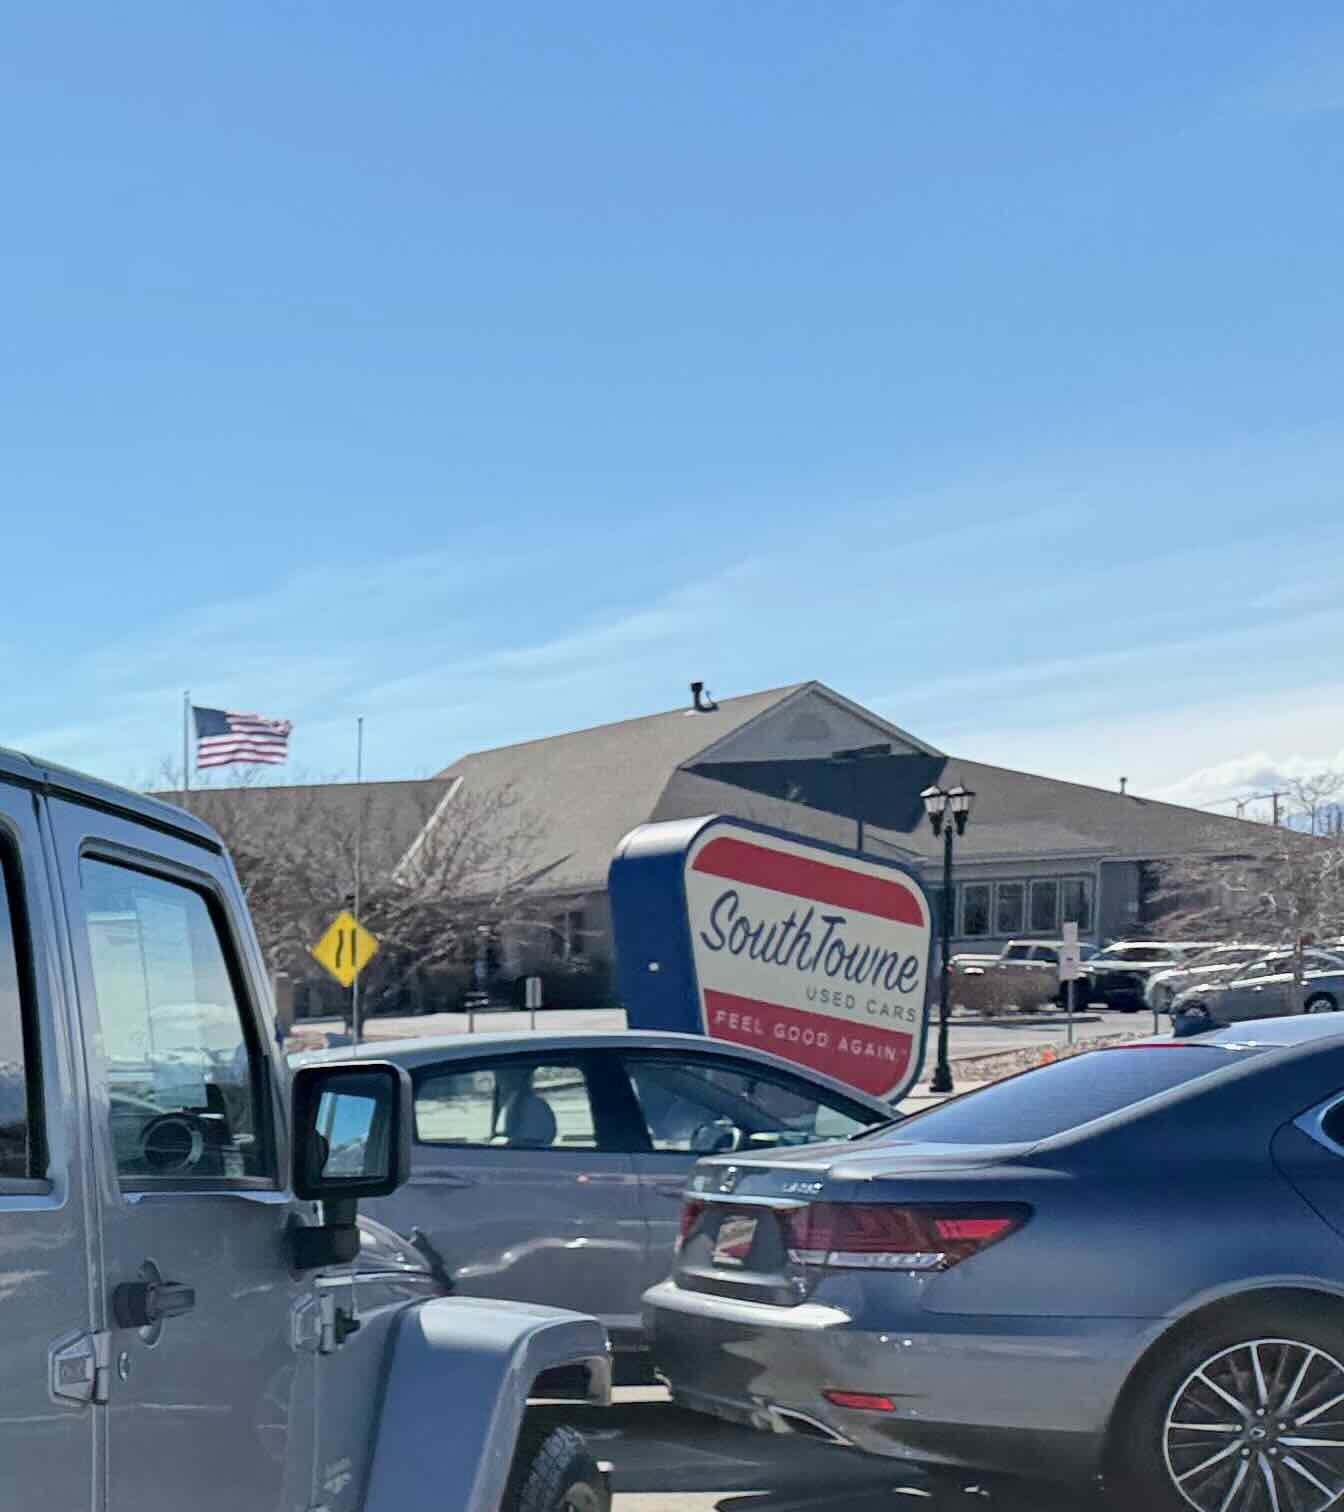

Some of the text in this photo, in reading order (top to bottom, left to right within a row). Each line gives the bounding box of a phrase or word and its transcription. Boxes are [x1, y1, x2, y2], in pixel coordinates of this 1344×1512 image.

[805, 984, 917, 1024] USED CARS
[713, 1009, 764, 1034] FEEL
[773, 1022, 830, 1048] GOOD
